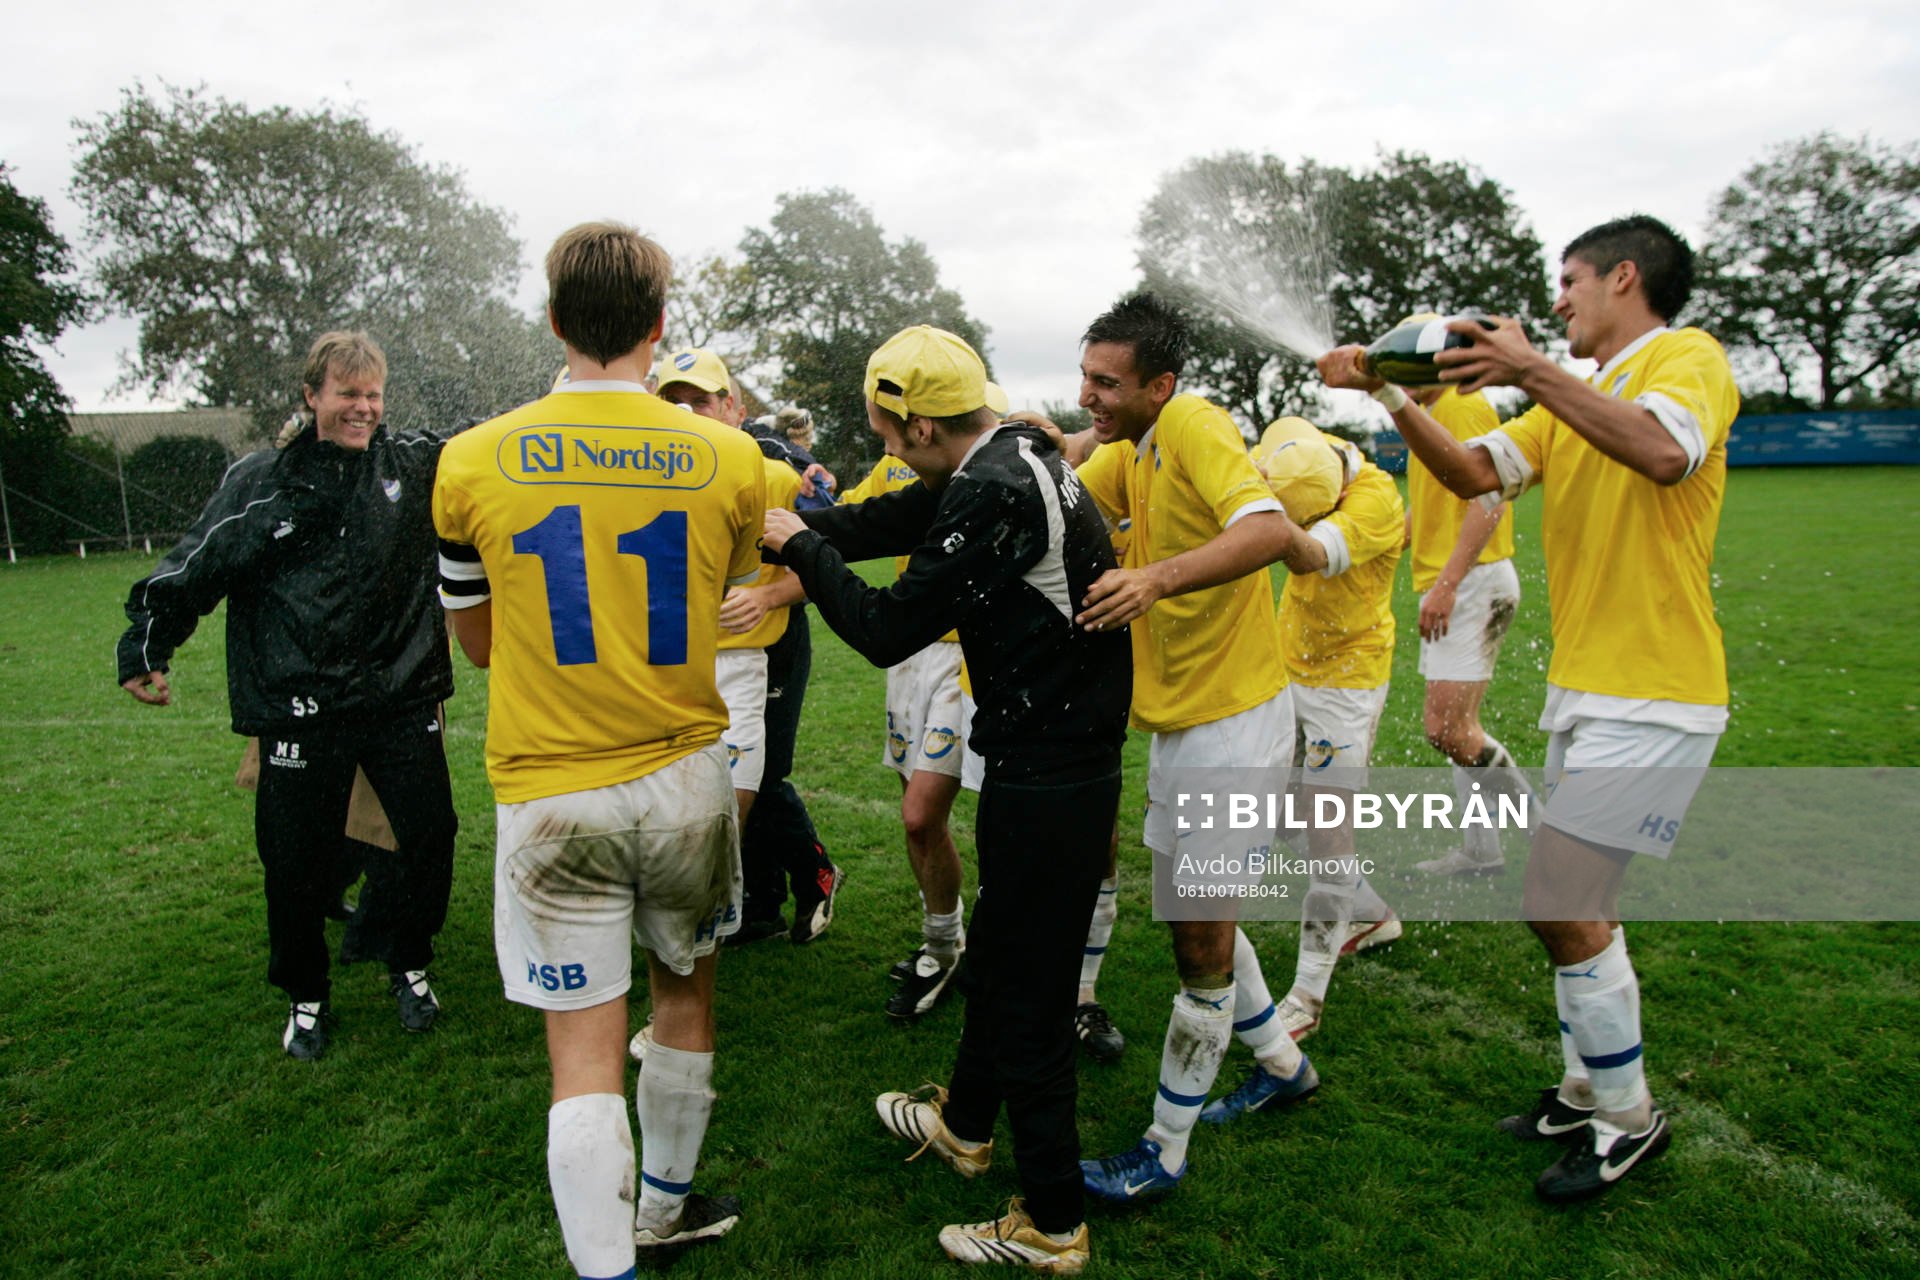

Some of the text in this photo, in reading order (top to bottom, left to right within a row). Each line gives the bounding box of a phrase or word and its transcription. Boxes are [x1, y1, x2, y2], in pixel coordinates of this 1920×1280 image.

[571, 438, 694, 480] Nordsjö
[511, 504, 688, 666] 11
[526, 957, 588, 991] HSB
